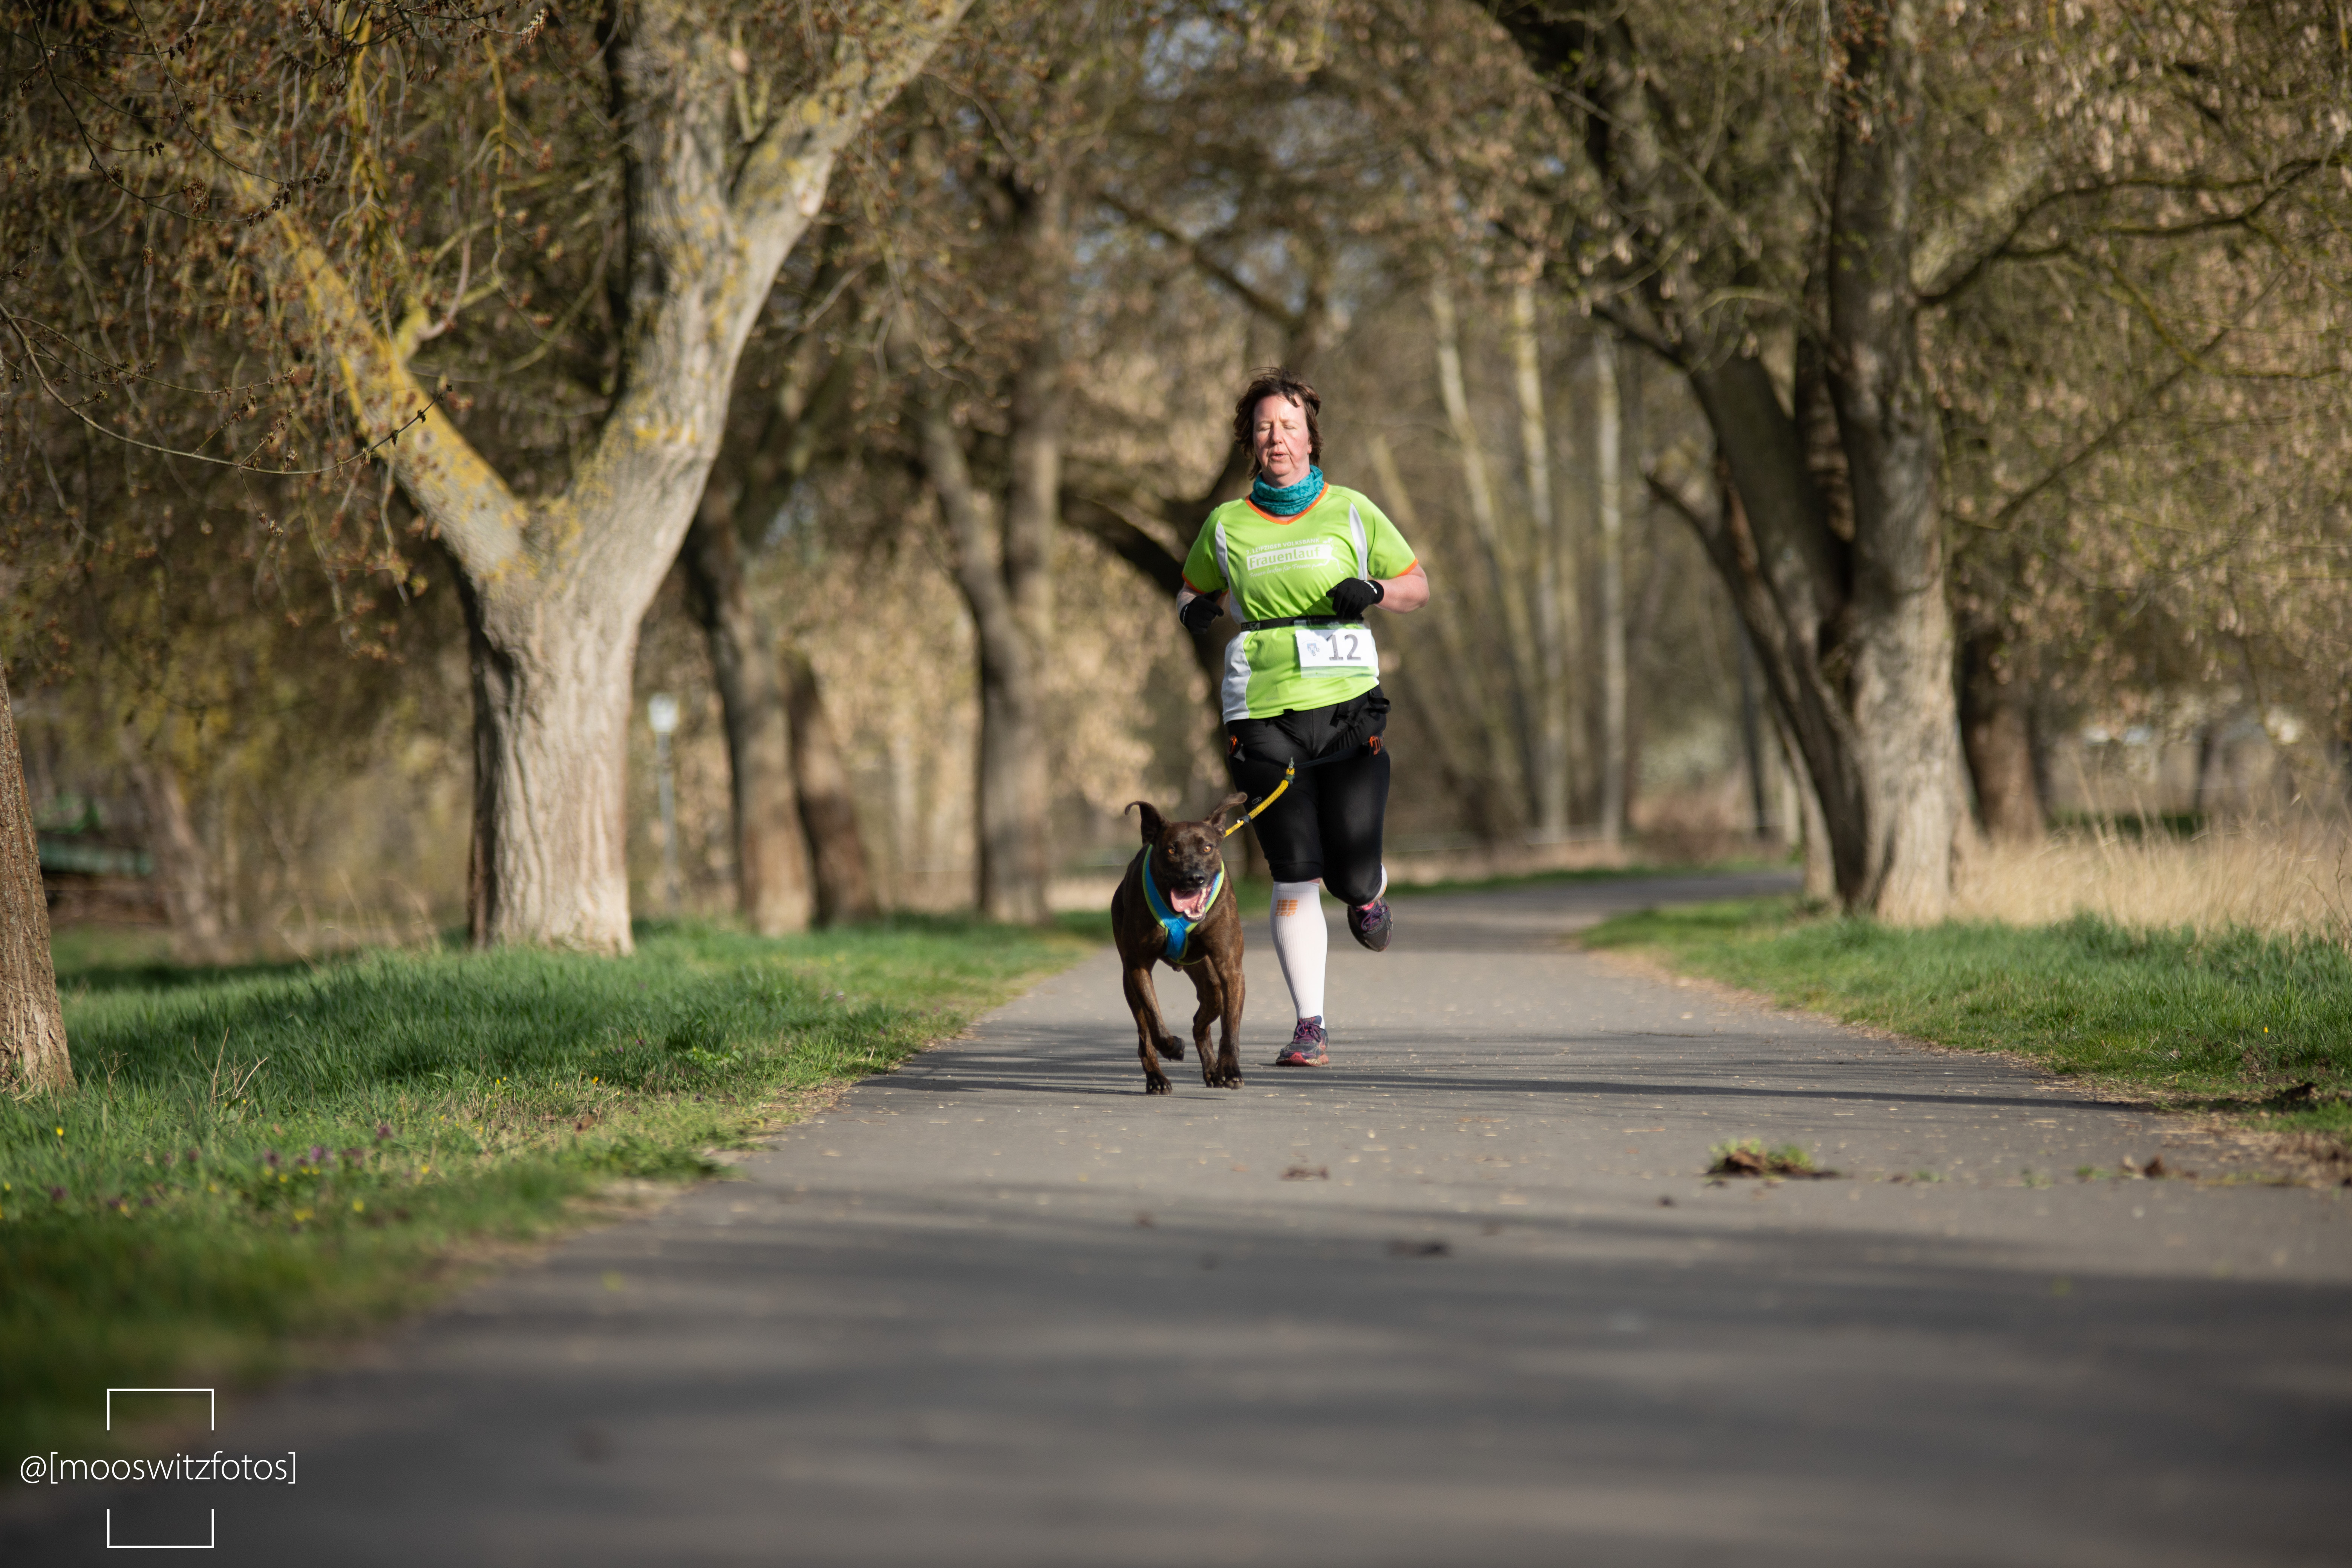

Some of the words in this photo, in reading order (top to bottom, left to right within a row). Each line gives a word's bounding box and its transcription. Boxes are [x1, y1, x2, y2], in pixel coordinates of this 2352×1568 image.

[1253, 544, 1281, 553] LEIPZIGER
[1283, 538, 1320, 547] VOLKSBANK
[1249, 547, 1320, 568] Frauenlauf
[1326, 634, 1361, 661] 12
